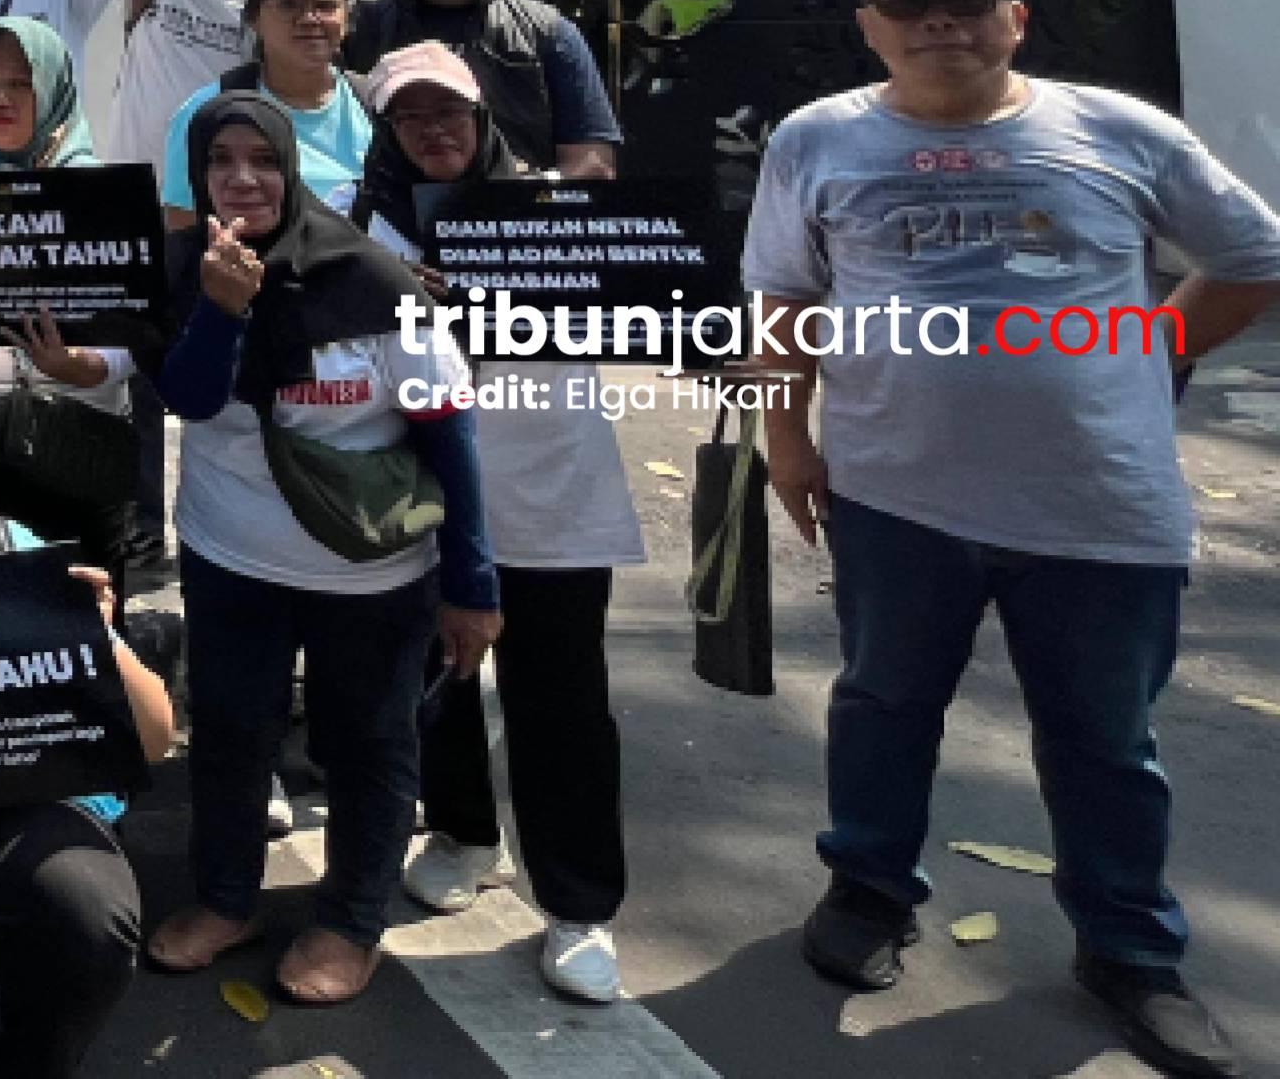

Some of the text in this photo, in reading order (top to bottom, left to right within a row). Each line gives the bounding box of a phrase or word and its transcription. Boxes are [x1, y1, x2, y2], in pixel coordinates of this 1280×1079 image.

[435, 218, 683, 238] DIAM BUKAN NETRAL
[41, 239, 132, 266] TAHU
[440, 246, 705, 264] DIAM ADALAH BENTUK
[78, 643, 97, 678] !
